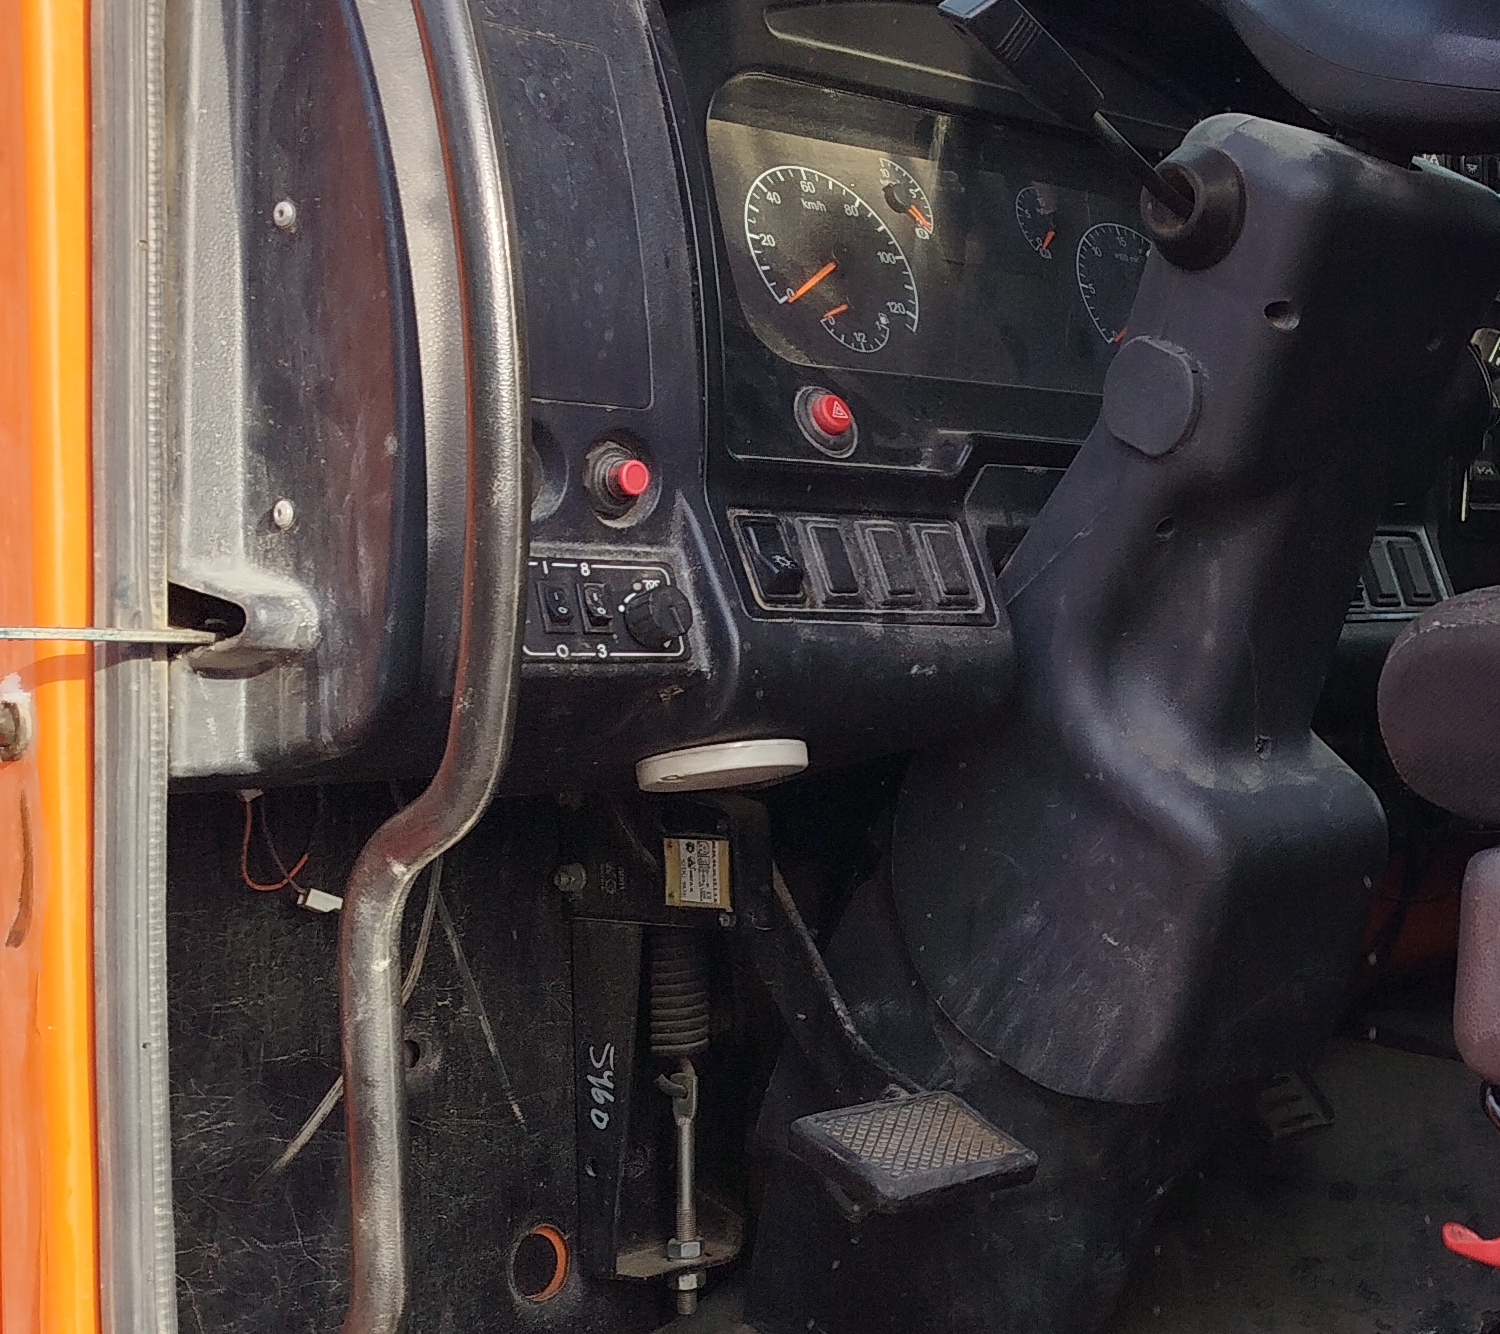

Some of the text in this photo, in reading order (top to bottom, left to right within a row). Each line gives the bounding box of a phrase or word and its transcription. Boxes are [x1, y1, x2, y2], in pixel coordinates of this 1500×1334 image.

[800, 180, 816, 194] 60
[766, 191, 782, 205] 40
[801, 197, 827, 213] km/h
[844, 204, 859, 217] 80
[760, 233, 776, 247] 20
[877, 251, 896, 265] 100
[887, 301, 906, 315] 120
[580, 562, 591, 577] 8
[596, 644, 608, 658] 3
